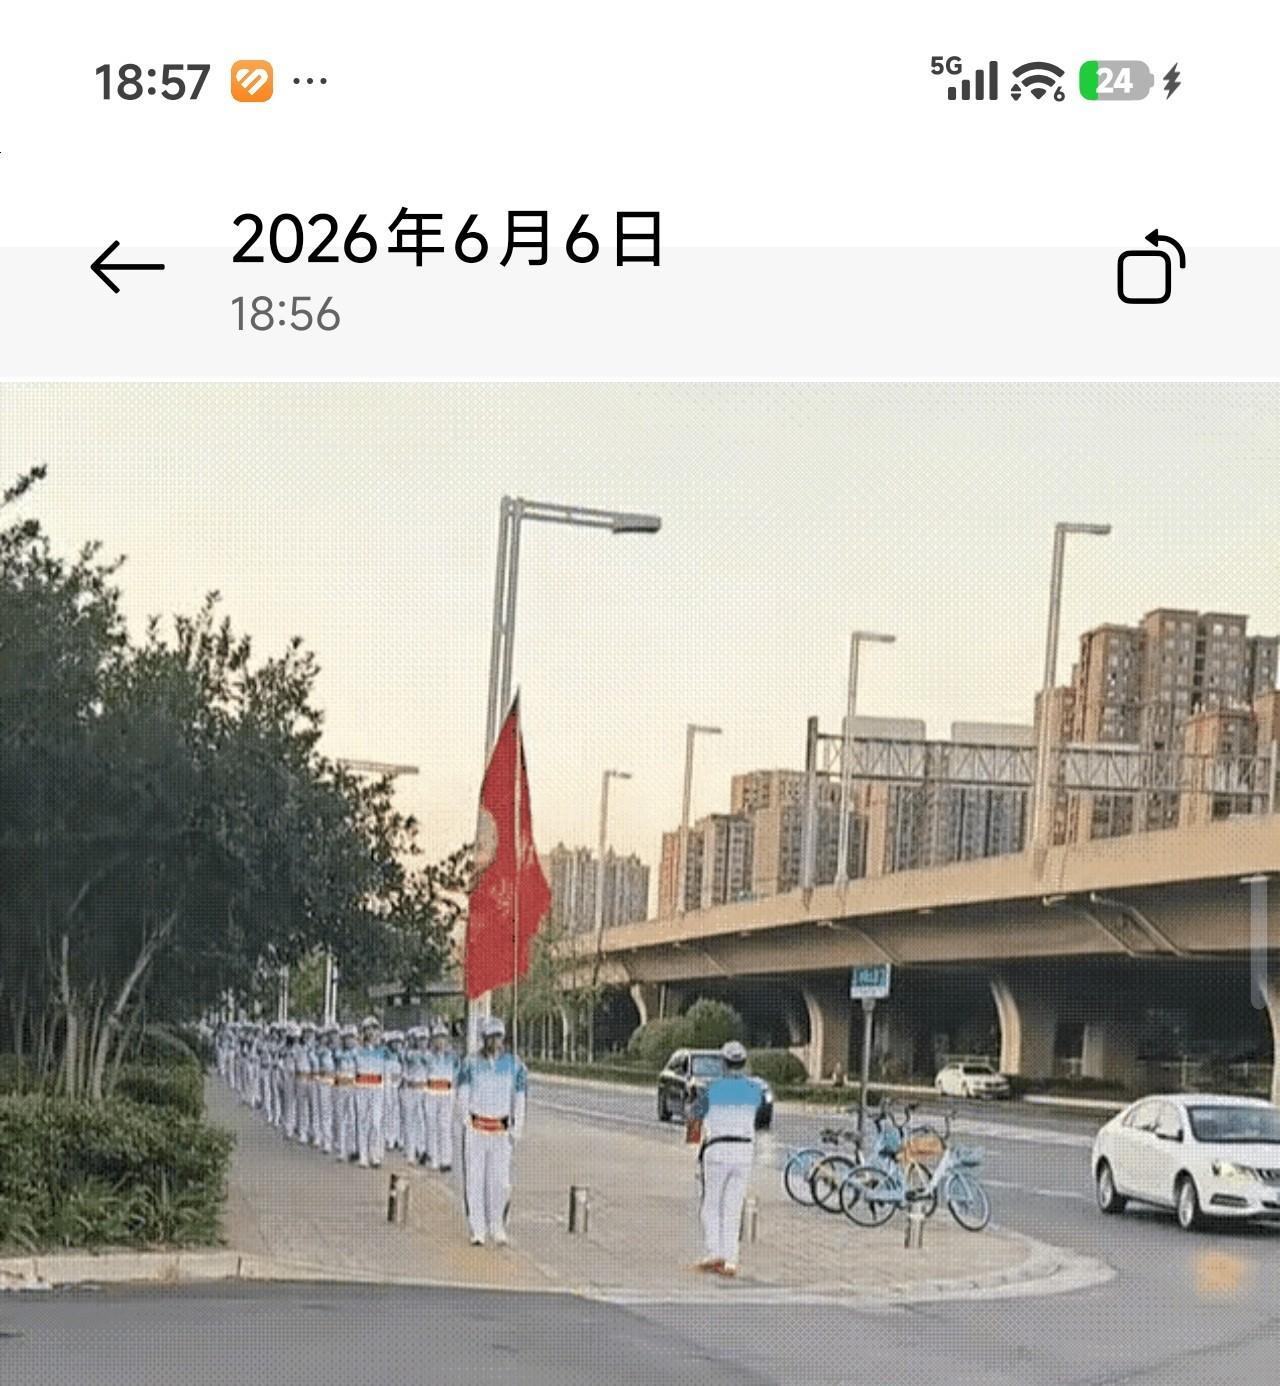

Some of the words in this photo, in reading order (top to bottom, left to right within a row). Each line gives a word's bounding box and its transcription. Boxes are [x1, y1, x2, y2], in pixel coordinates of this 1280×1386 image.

[95, 63, 211, 101] 18:57
[930, 55, 963, 76] 5G
[1096, 67, 1134, 94] 24
[231, 206, 664, 268] 2026年6月6日
[231, 295, 341, 332] 18:56
